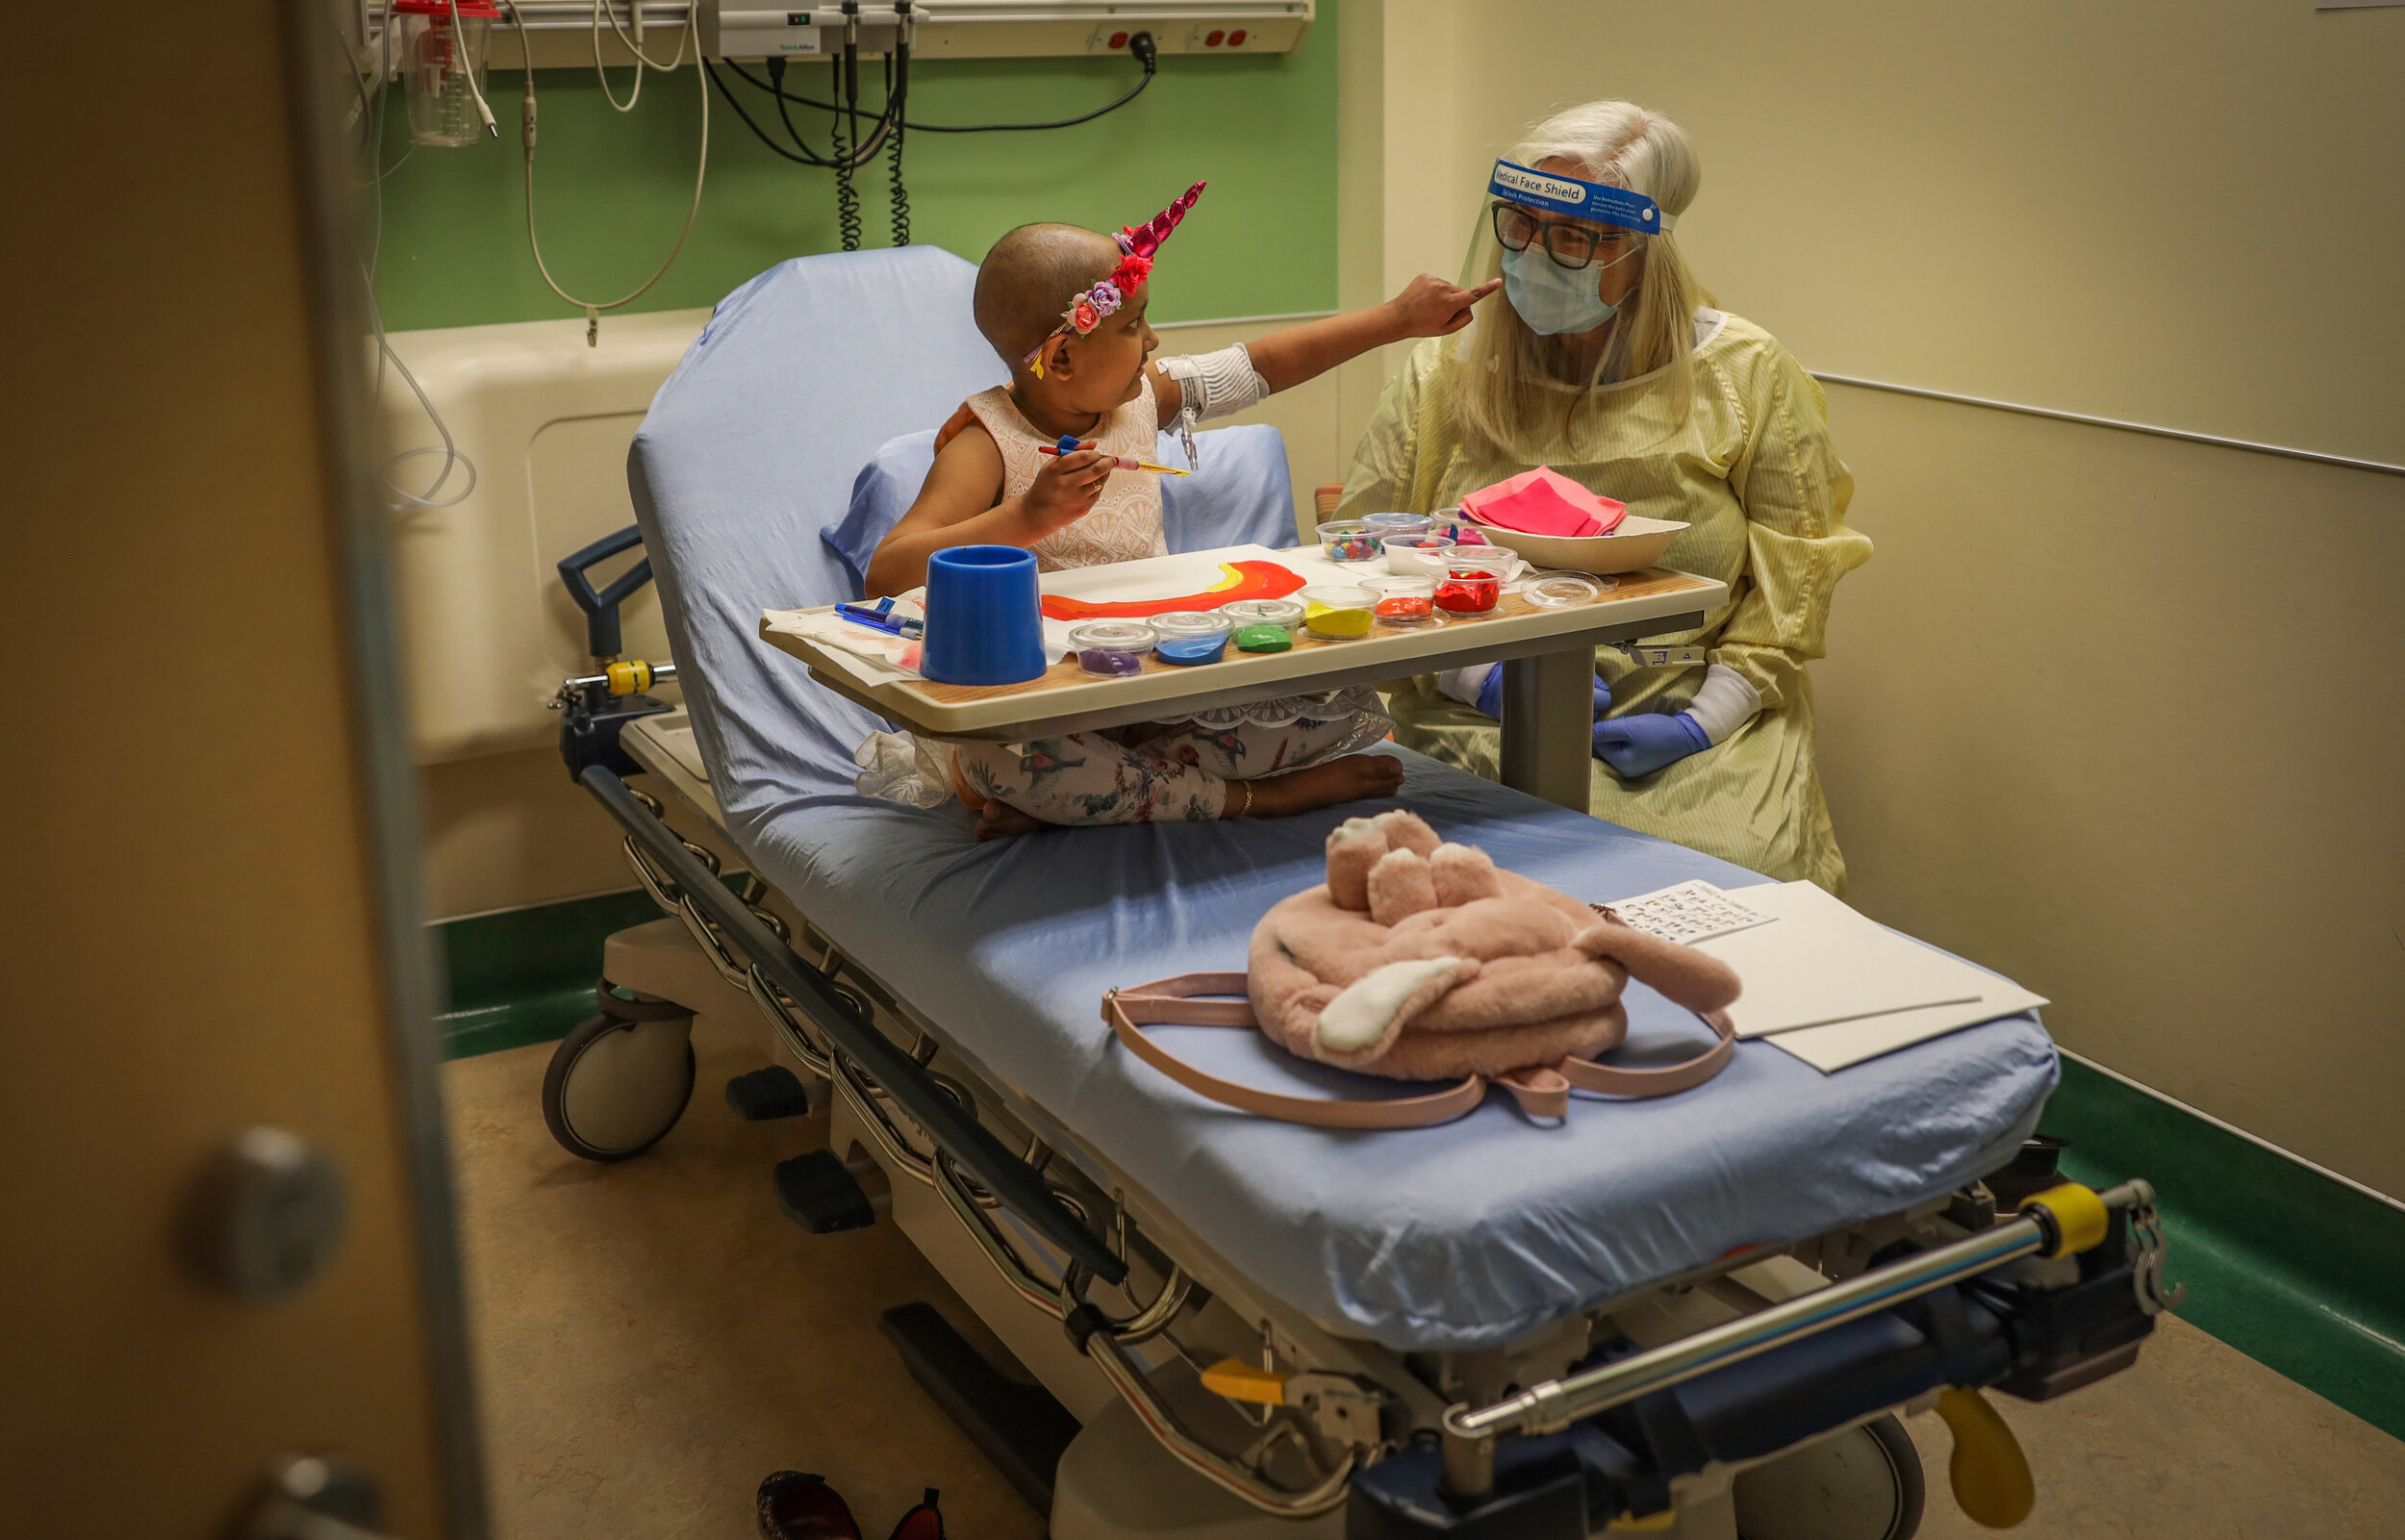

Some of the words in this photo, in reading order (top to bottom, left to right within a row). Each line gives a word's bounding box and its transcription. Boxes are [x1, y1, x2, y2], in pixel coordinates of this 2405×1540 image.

[1520, 177, 1541, 190] Face
[1545, 183, 1580, 199] Shield
[1518, 193, 1549, 206] Protection
